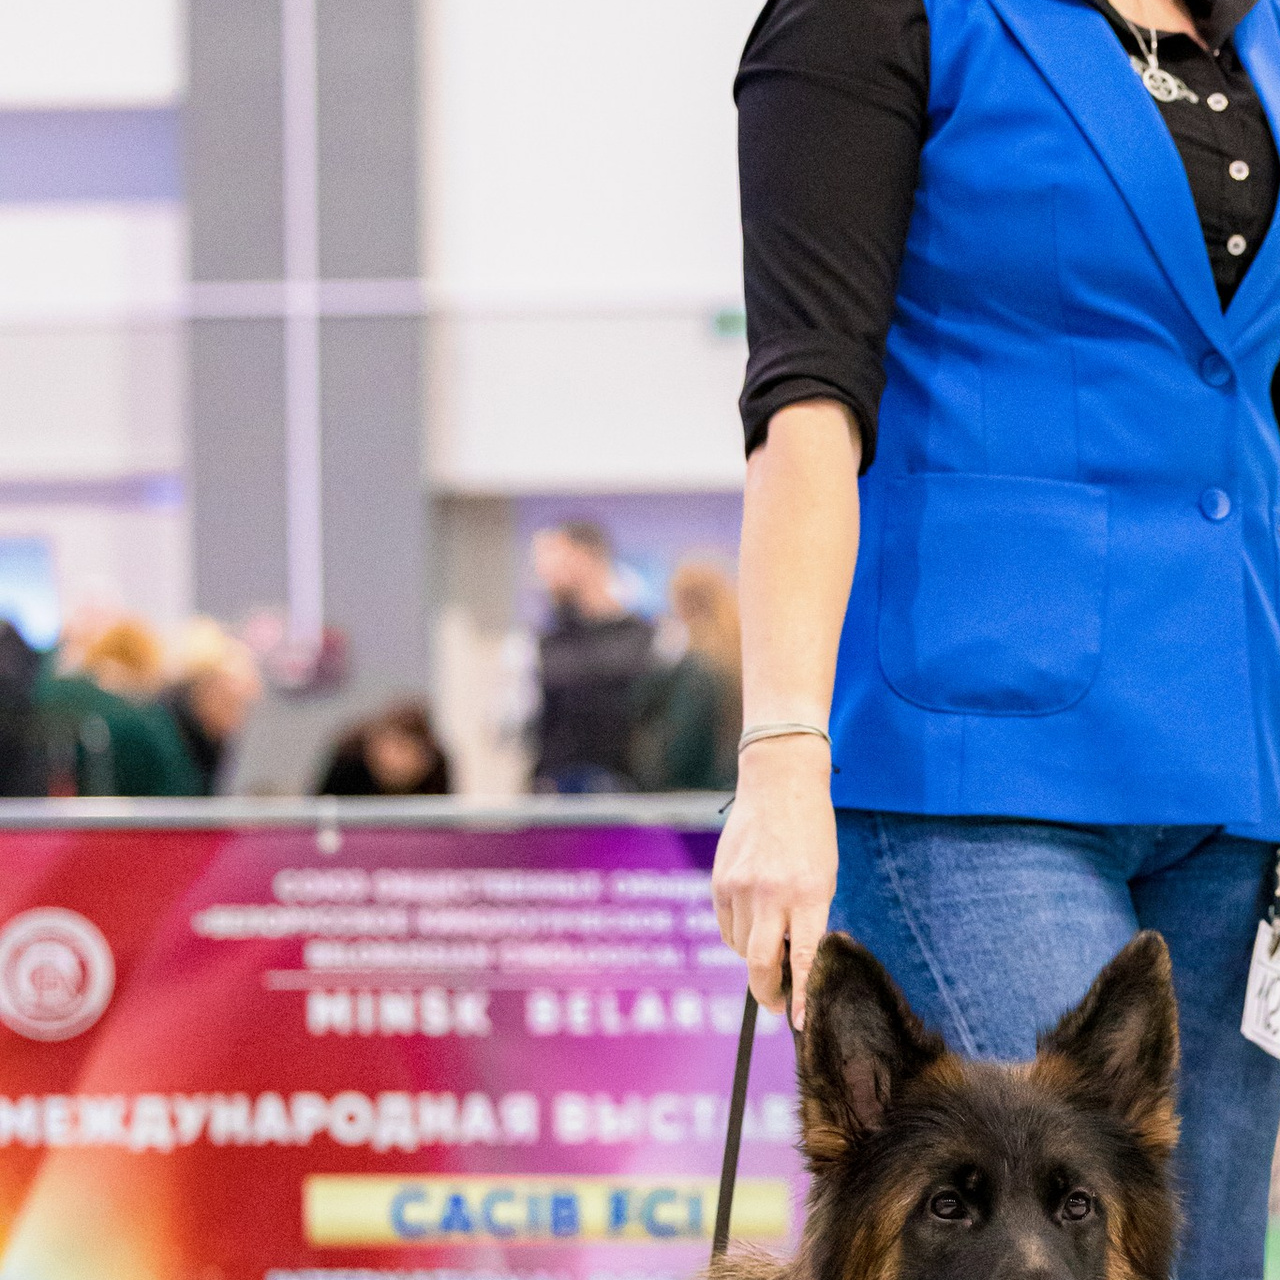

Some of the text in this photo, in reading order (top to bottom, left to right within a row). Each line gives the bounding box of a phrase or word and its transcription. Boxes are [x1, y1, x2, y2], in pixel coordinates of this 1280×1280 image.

[306, 989, 492, 1037] MINSK
[0, 1090, 800, 1153] МЕЖДУНАРОДНАЯ ВЫСТАВ
[390, 1186, 706, 1238] CACIB FCI
